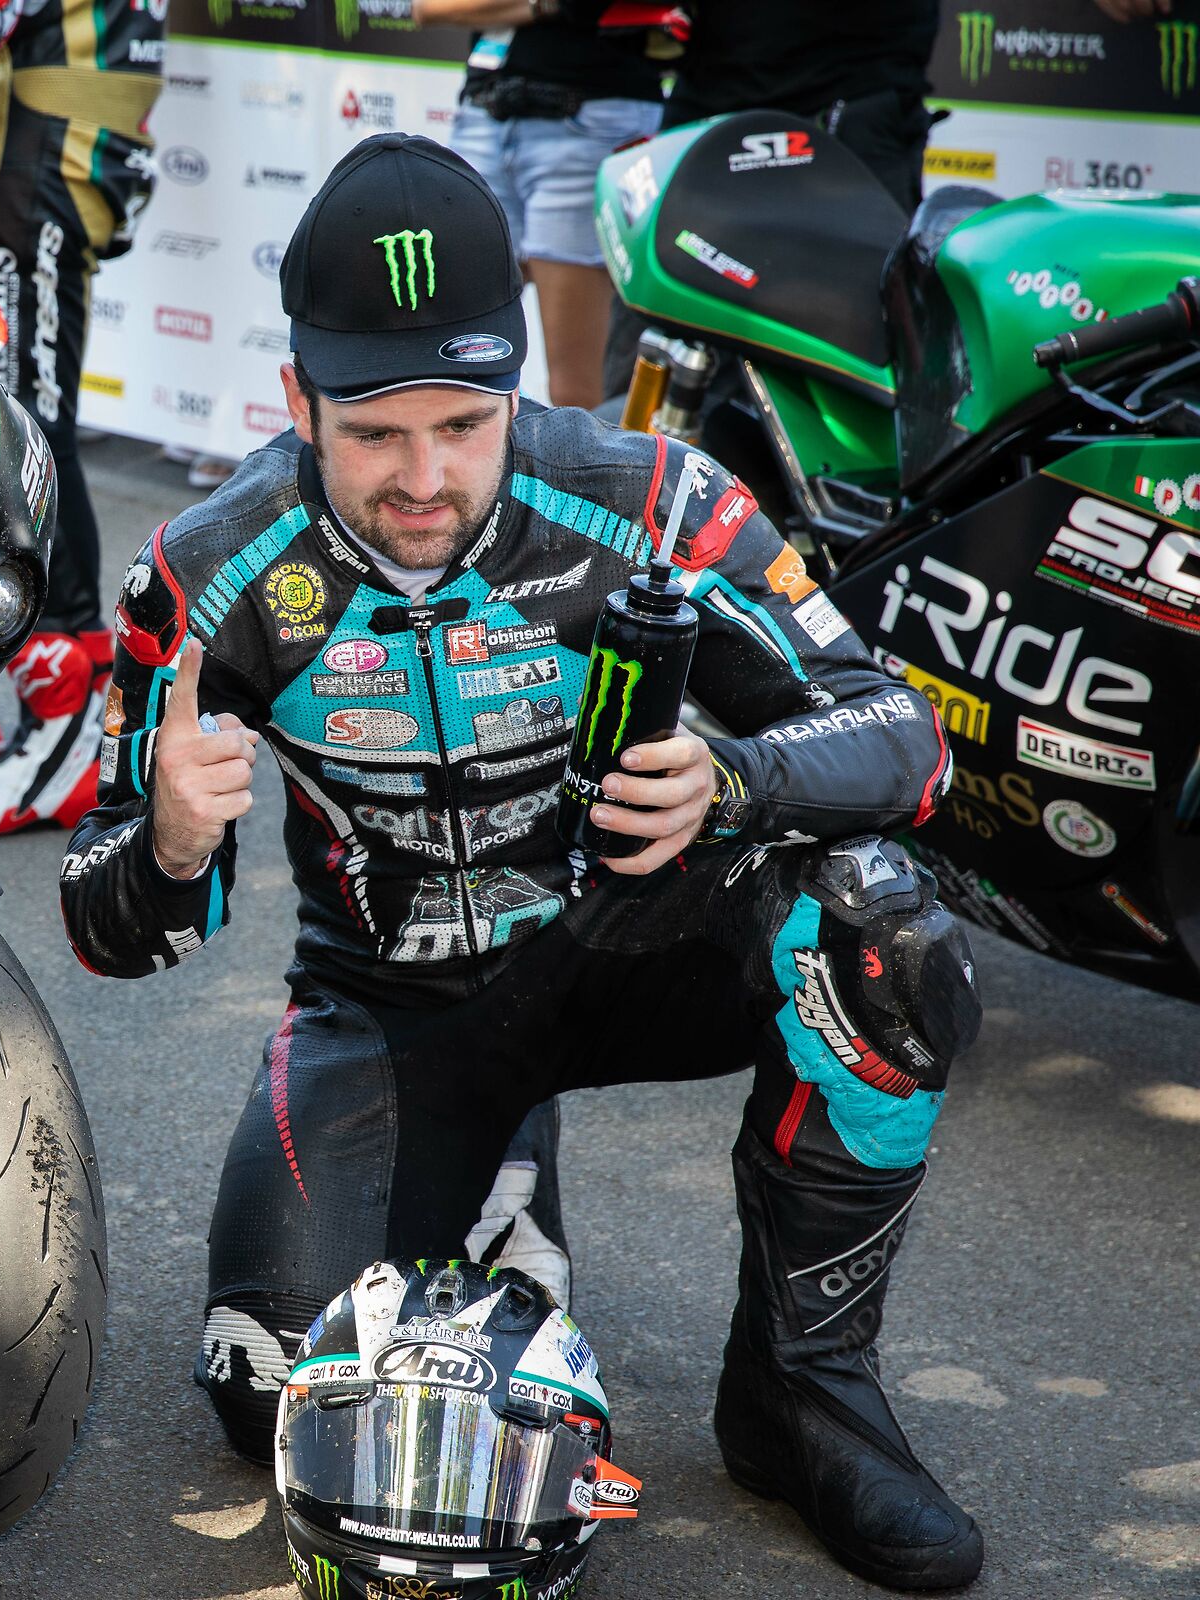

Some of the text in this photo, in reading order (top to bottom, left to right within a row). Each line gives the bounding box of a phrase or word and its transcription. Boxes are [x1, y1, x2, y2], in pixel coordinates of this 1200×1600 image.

[1025, 732, 1143, 778] DELLORTO
[424, 1326, 492, 1349] FAIRBURN
[379, 1345, 481, 1385] Arai
[551, 1391, 572, 1410] cox
[596, 1482, 633, 1500] Arai
[339, 1516, 481, 1549] WWW.PROSPERITY-WEALTH.CO.UK
